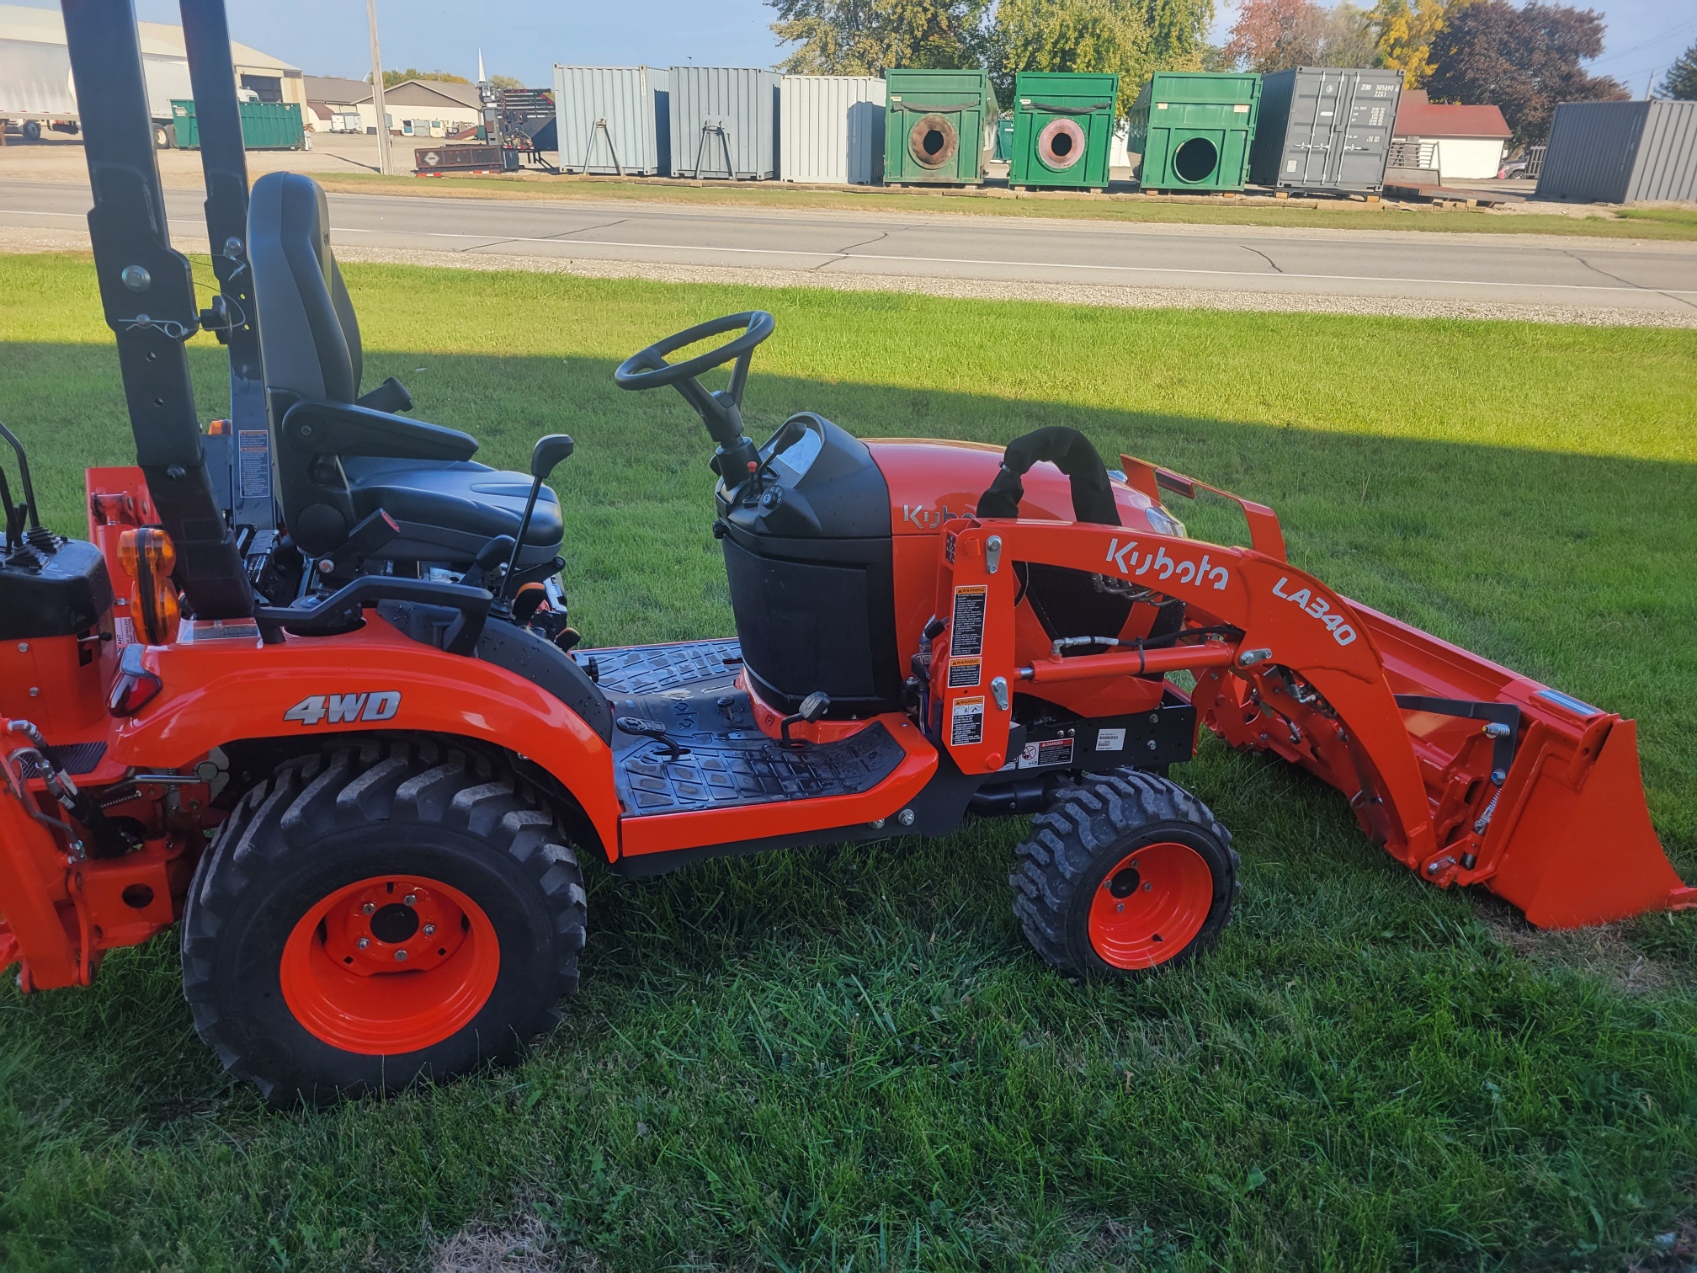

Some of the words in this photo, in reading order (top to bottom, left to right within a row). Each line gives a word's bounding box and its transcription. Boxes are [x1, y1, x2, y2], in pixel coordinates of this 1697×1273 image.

[1105, 538, 1229, 590] Kubota
[1272, 576, 1357, 646] LA340
[283, 690, 402, 725] 4WD
